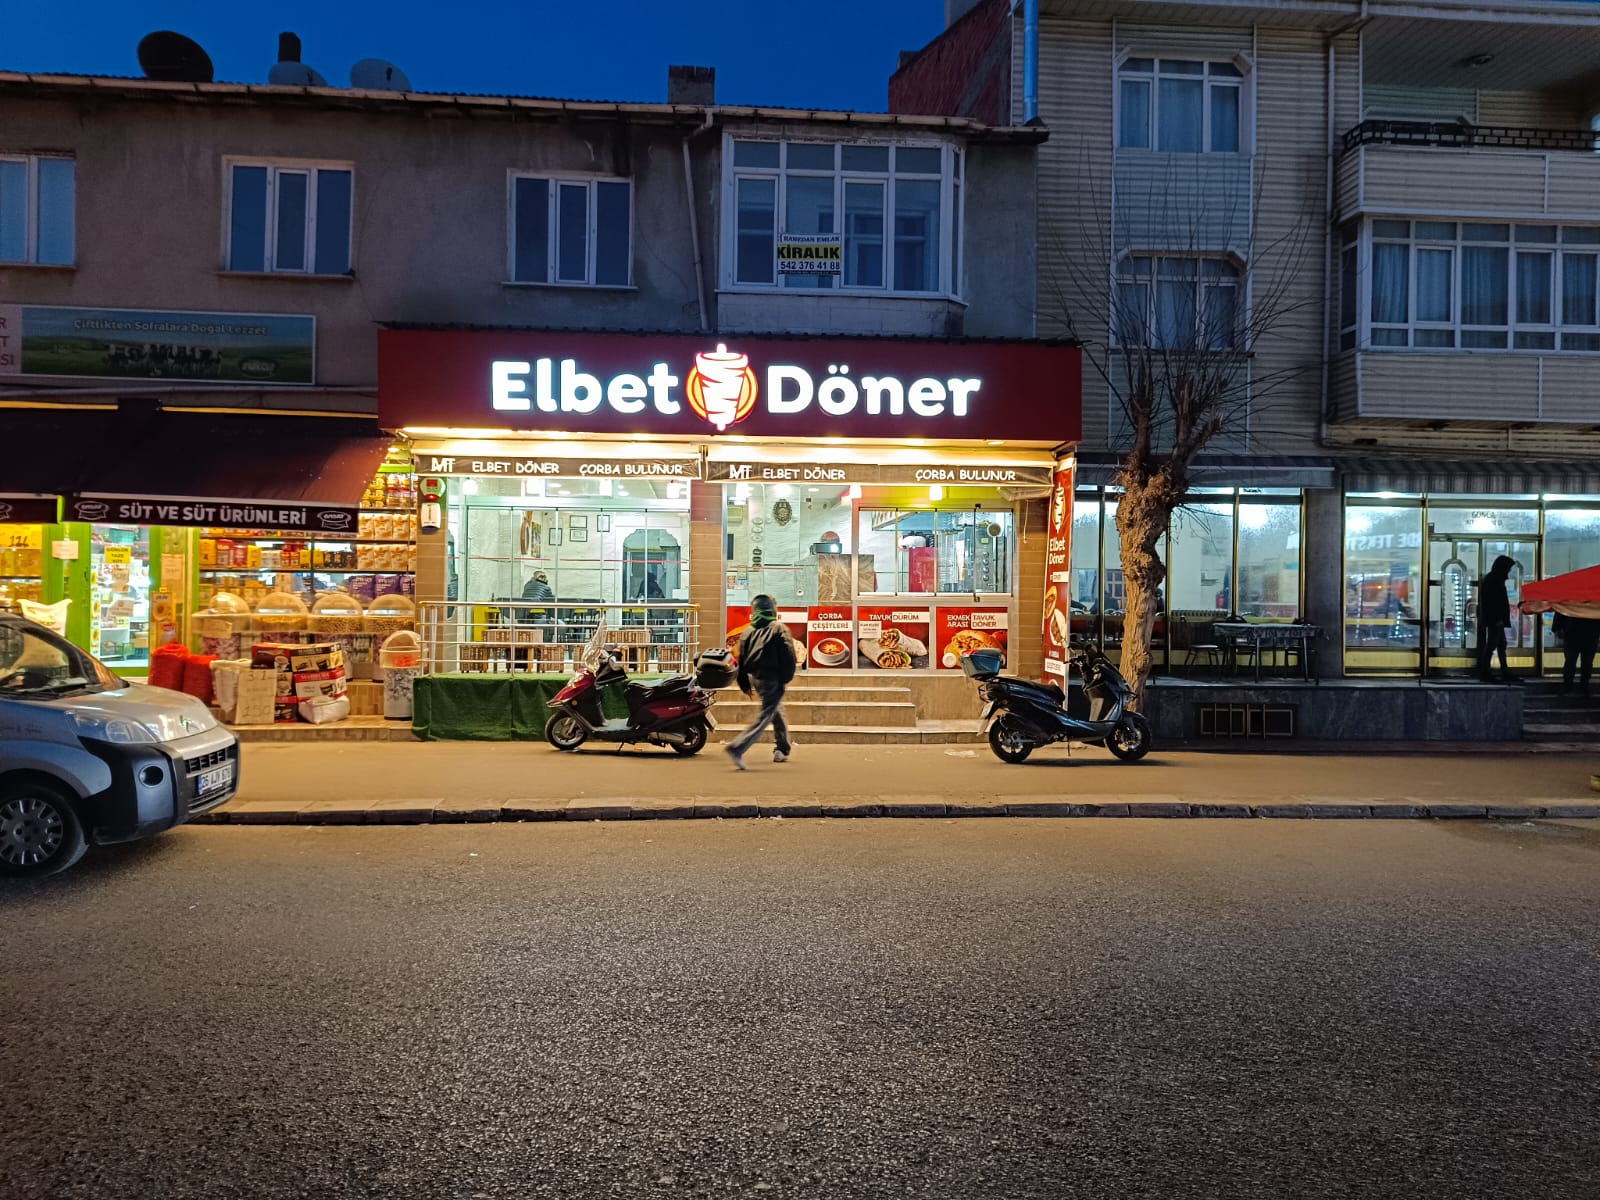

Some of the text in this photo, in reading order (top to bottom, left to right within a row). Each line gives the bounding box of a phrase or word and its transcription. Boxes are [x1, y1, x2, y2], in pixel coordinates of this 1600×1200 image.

[778, 244, 840, 259] KİRALIK
[781, 261, 797, 270] 542
[799, 261, 815, 270] 376
[817, 261, 827, 270] 41
[135, 321, 188, 332] Sofralara
[490, 357, 982, 417] Elbet Döner
[472, 461, 511, 473] ELBET
[516, 460, 560, 474] DÖNER
[579, 463, 683, 476] ÇORBA BULUNUR
[763, 468, 800, 479] ELBET
[804, 467, 846, 480] DÖNER
[915, 469, 1016, 482] ÇORBA BULUNUR
[119, 503, 153, 519] SÜT
[156, 506, 179, 520] VE
[182, 505, 216, 521] SÜT
[219, 505, 307, 525] ÜRÜNLERİ
[1050, 536, 1065, 551] Elbet
[1049, 553, 1065, 565] Döner
[818, 613, 843, 621] ÇORBA
[893, 612, 920, 621] DÜRÜM
[812, 621, 850, 631] ÇEŞİTLERİ
[972, 620, 997, 628] DÖNER
